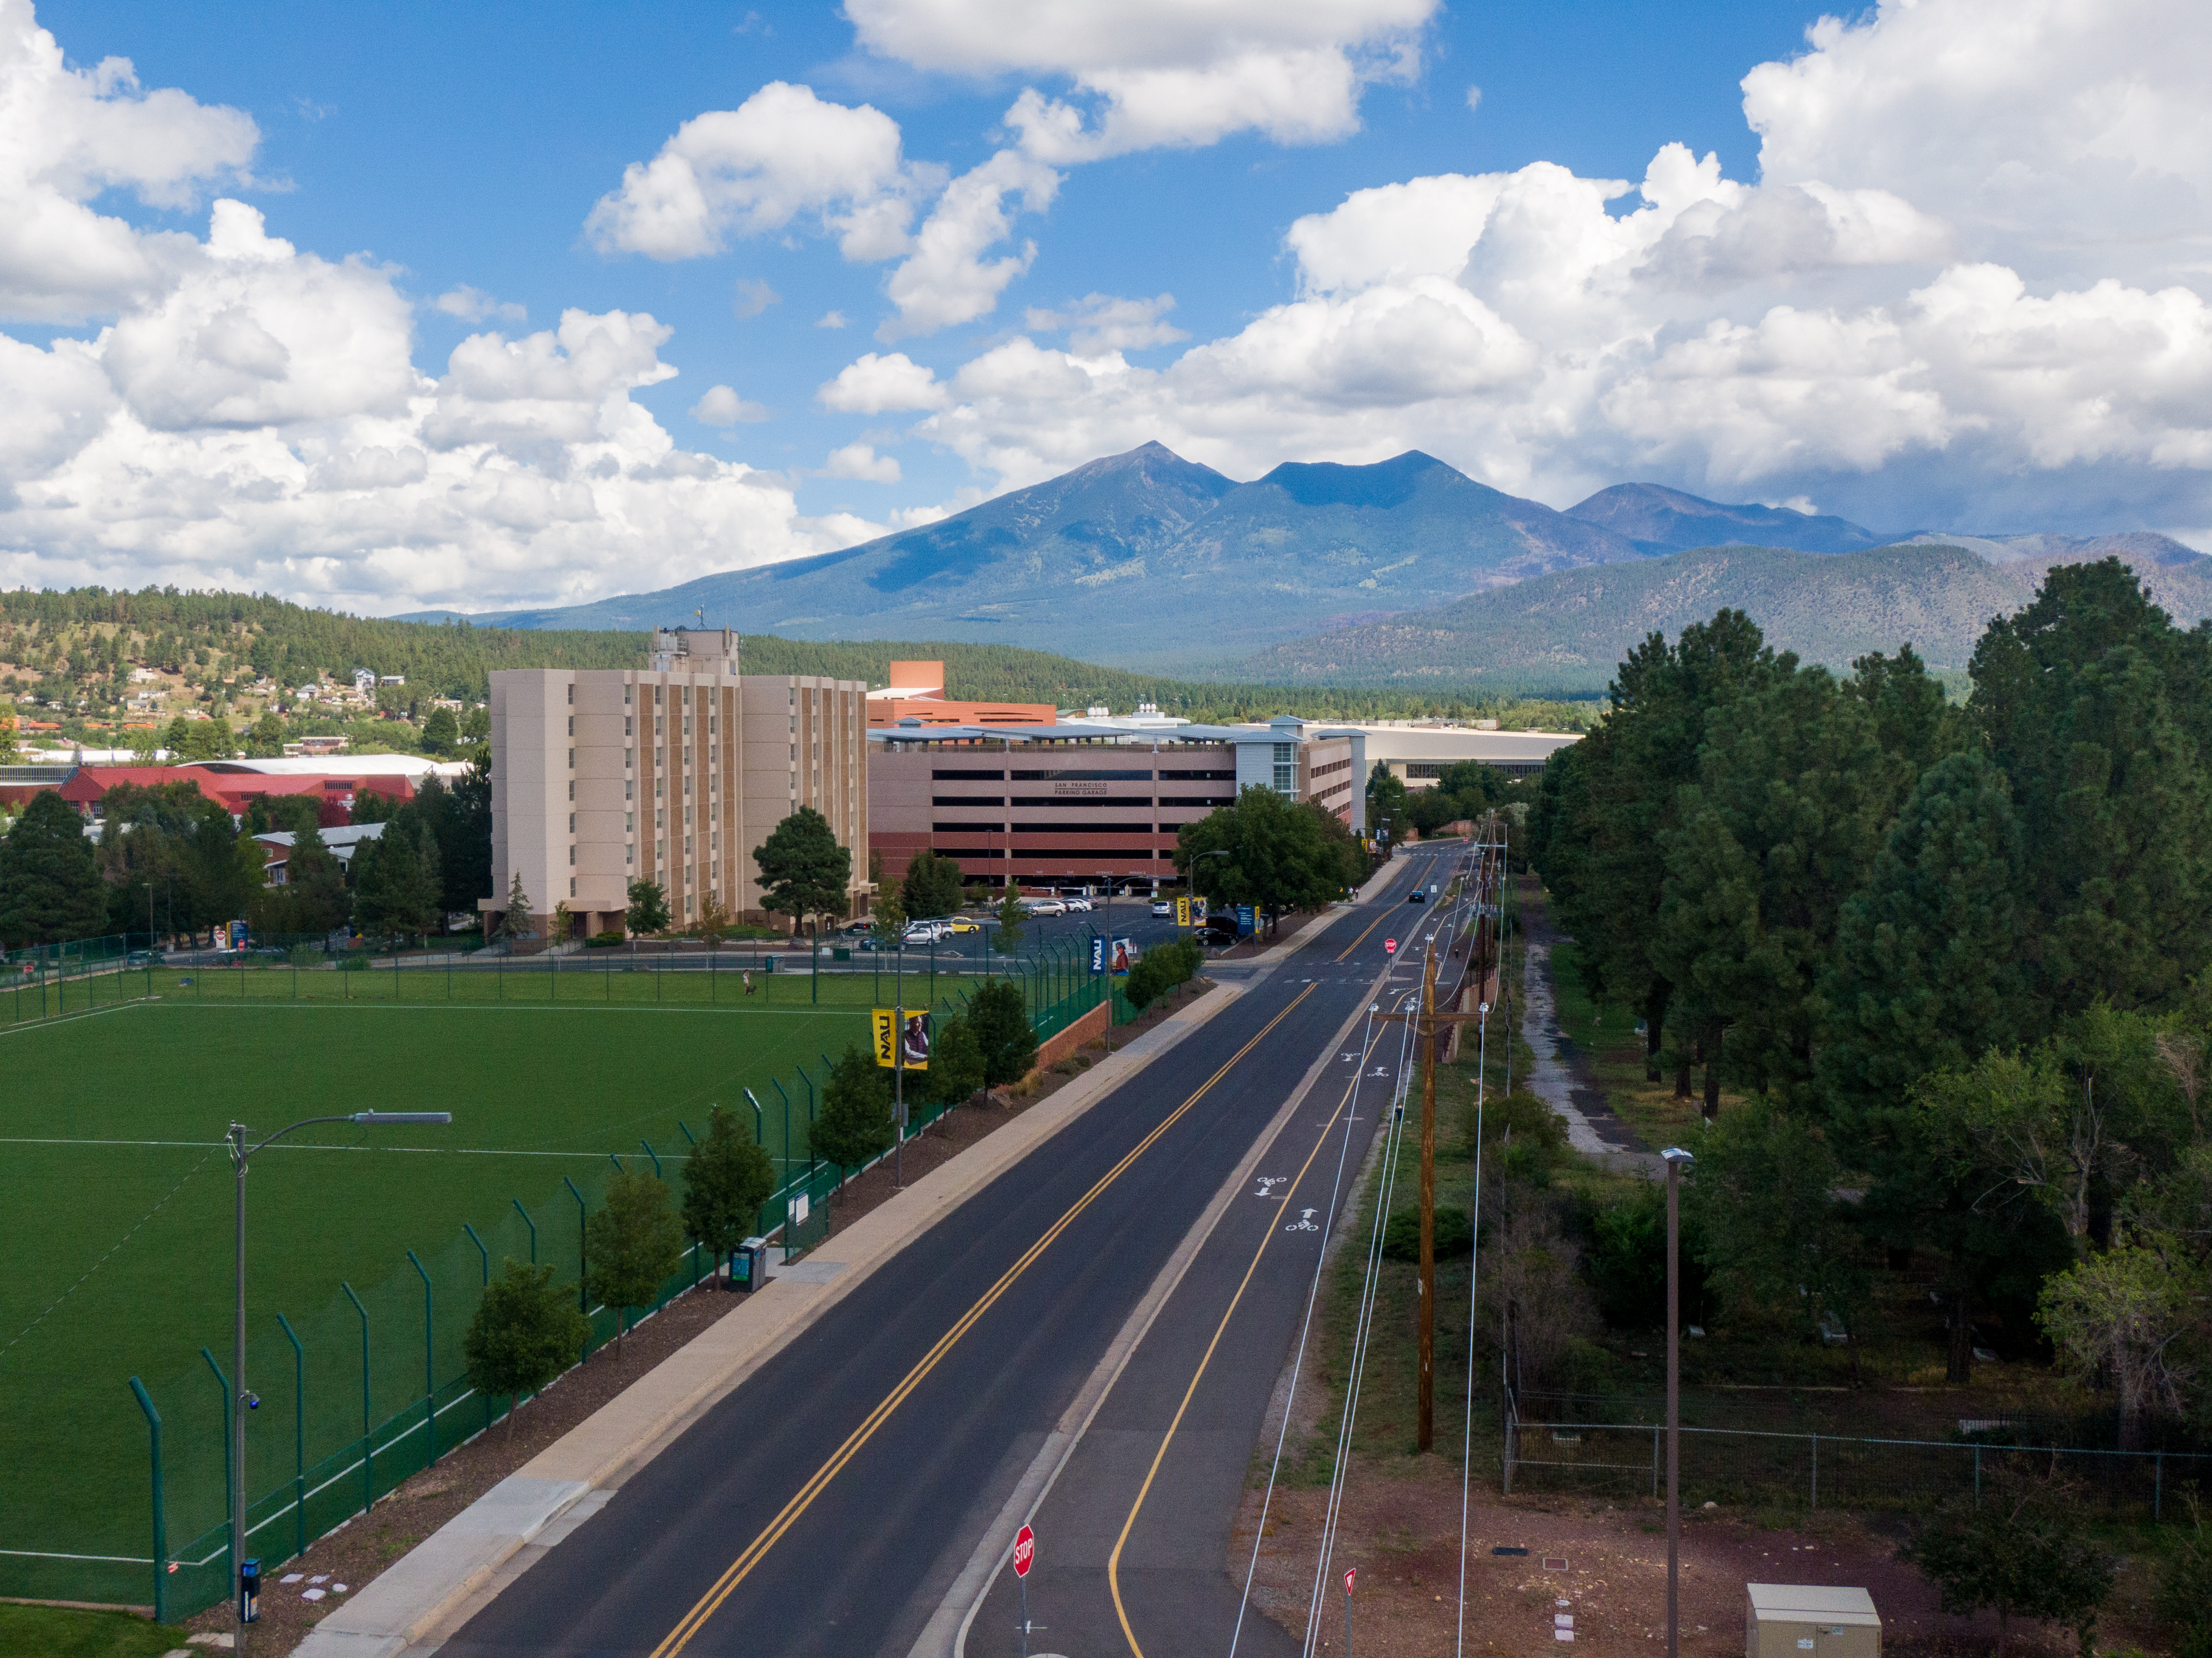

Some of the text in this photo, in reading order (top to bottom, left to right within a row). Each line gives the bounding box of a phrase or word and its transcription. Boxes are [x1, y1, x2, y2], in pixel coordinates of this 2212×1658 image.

[1093, 940, 1102, 970] NAU
[879, 1016, 891, 1060] NAU
[1015, 1538, 1032, 1564] STOP
